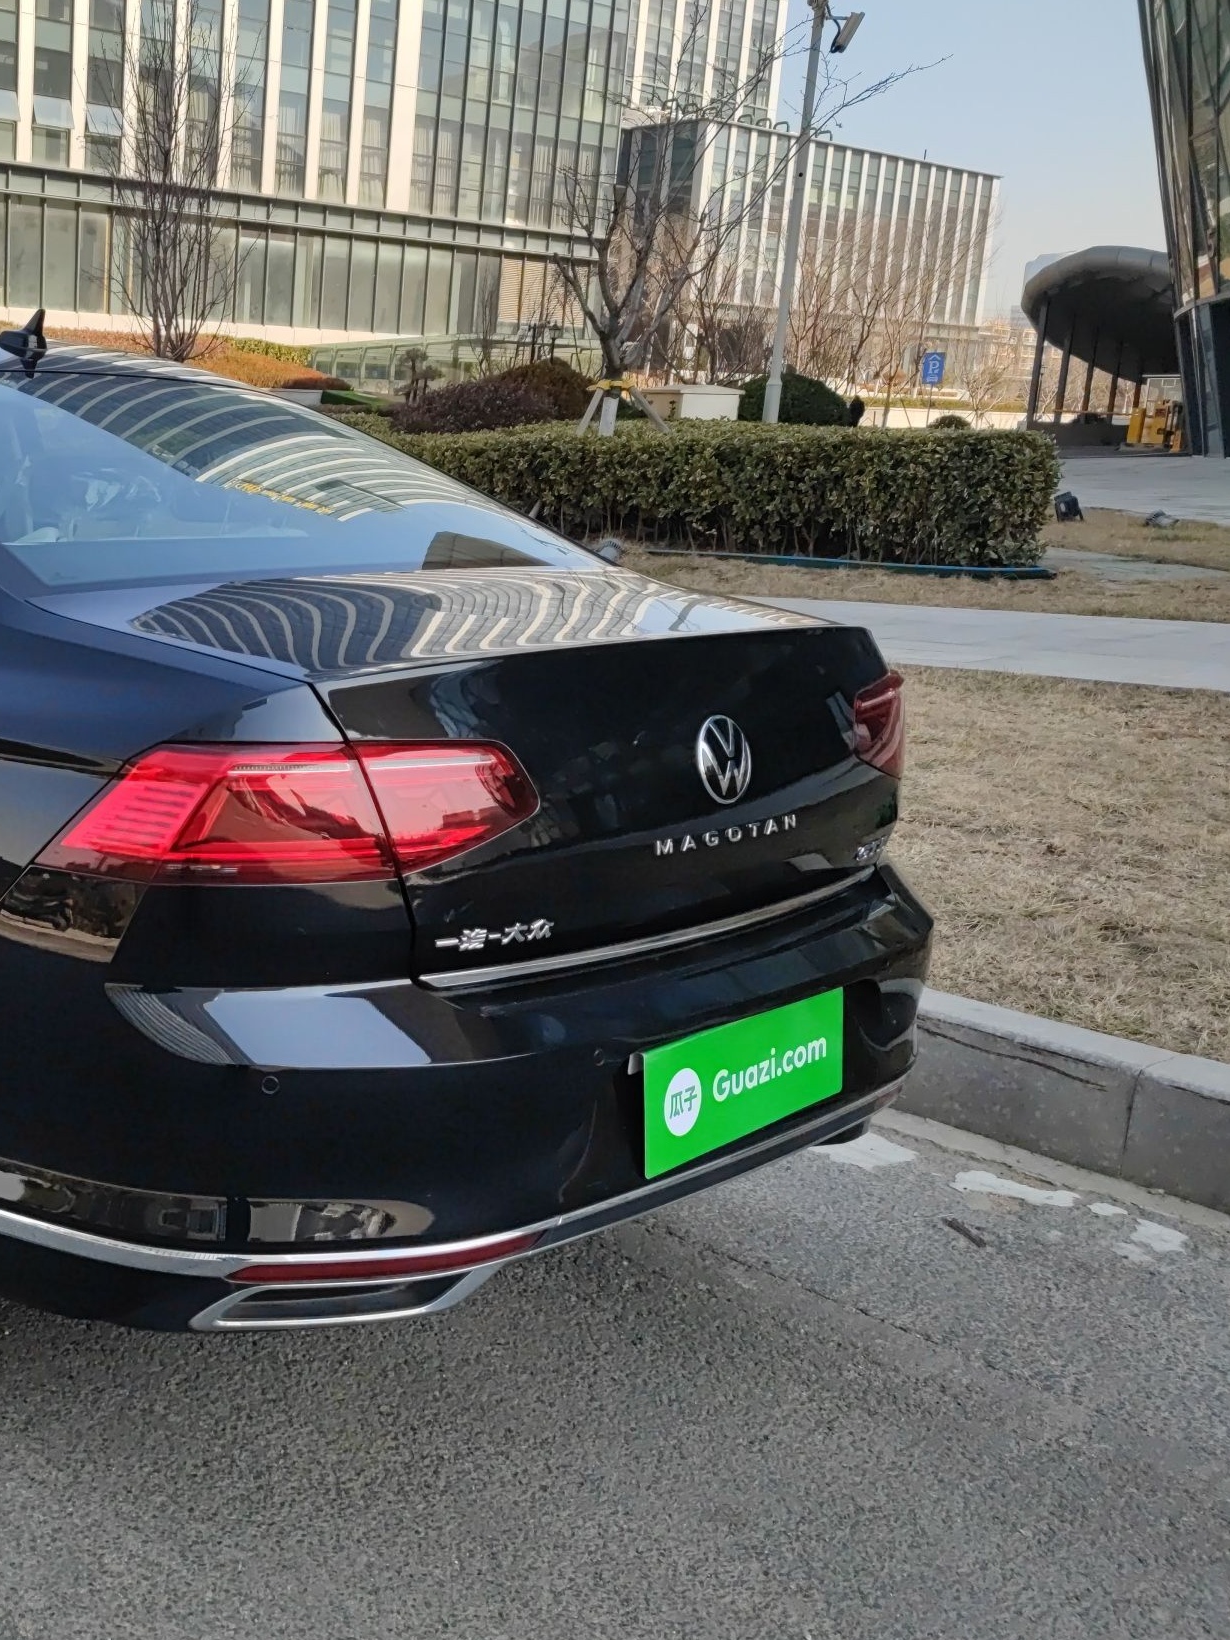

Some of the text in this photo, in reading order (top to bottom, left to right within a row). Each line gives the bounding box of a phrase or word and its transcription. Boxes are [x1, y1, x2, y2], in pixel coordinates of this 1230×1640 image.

[928, 360, 939, 374] P
[655, 814, 796, 856] MAGOTAN
[712, 1036, 827, 1102] Guazi.com
[669, 1085, 698, 1120] 瓜子
